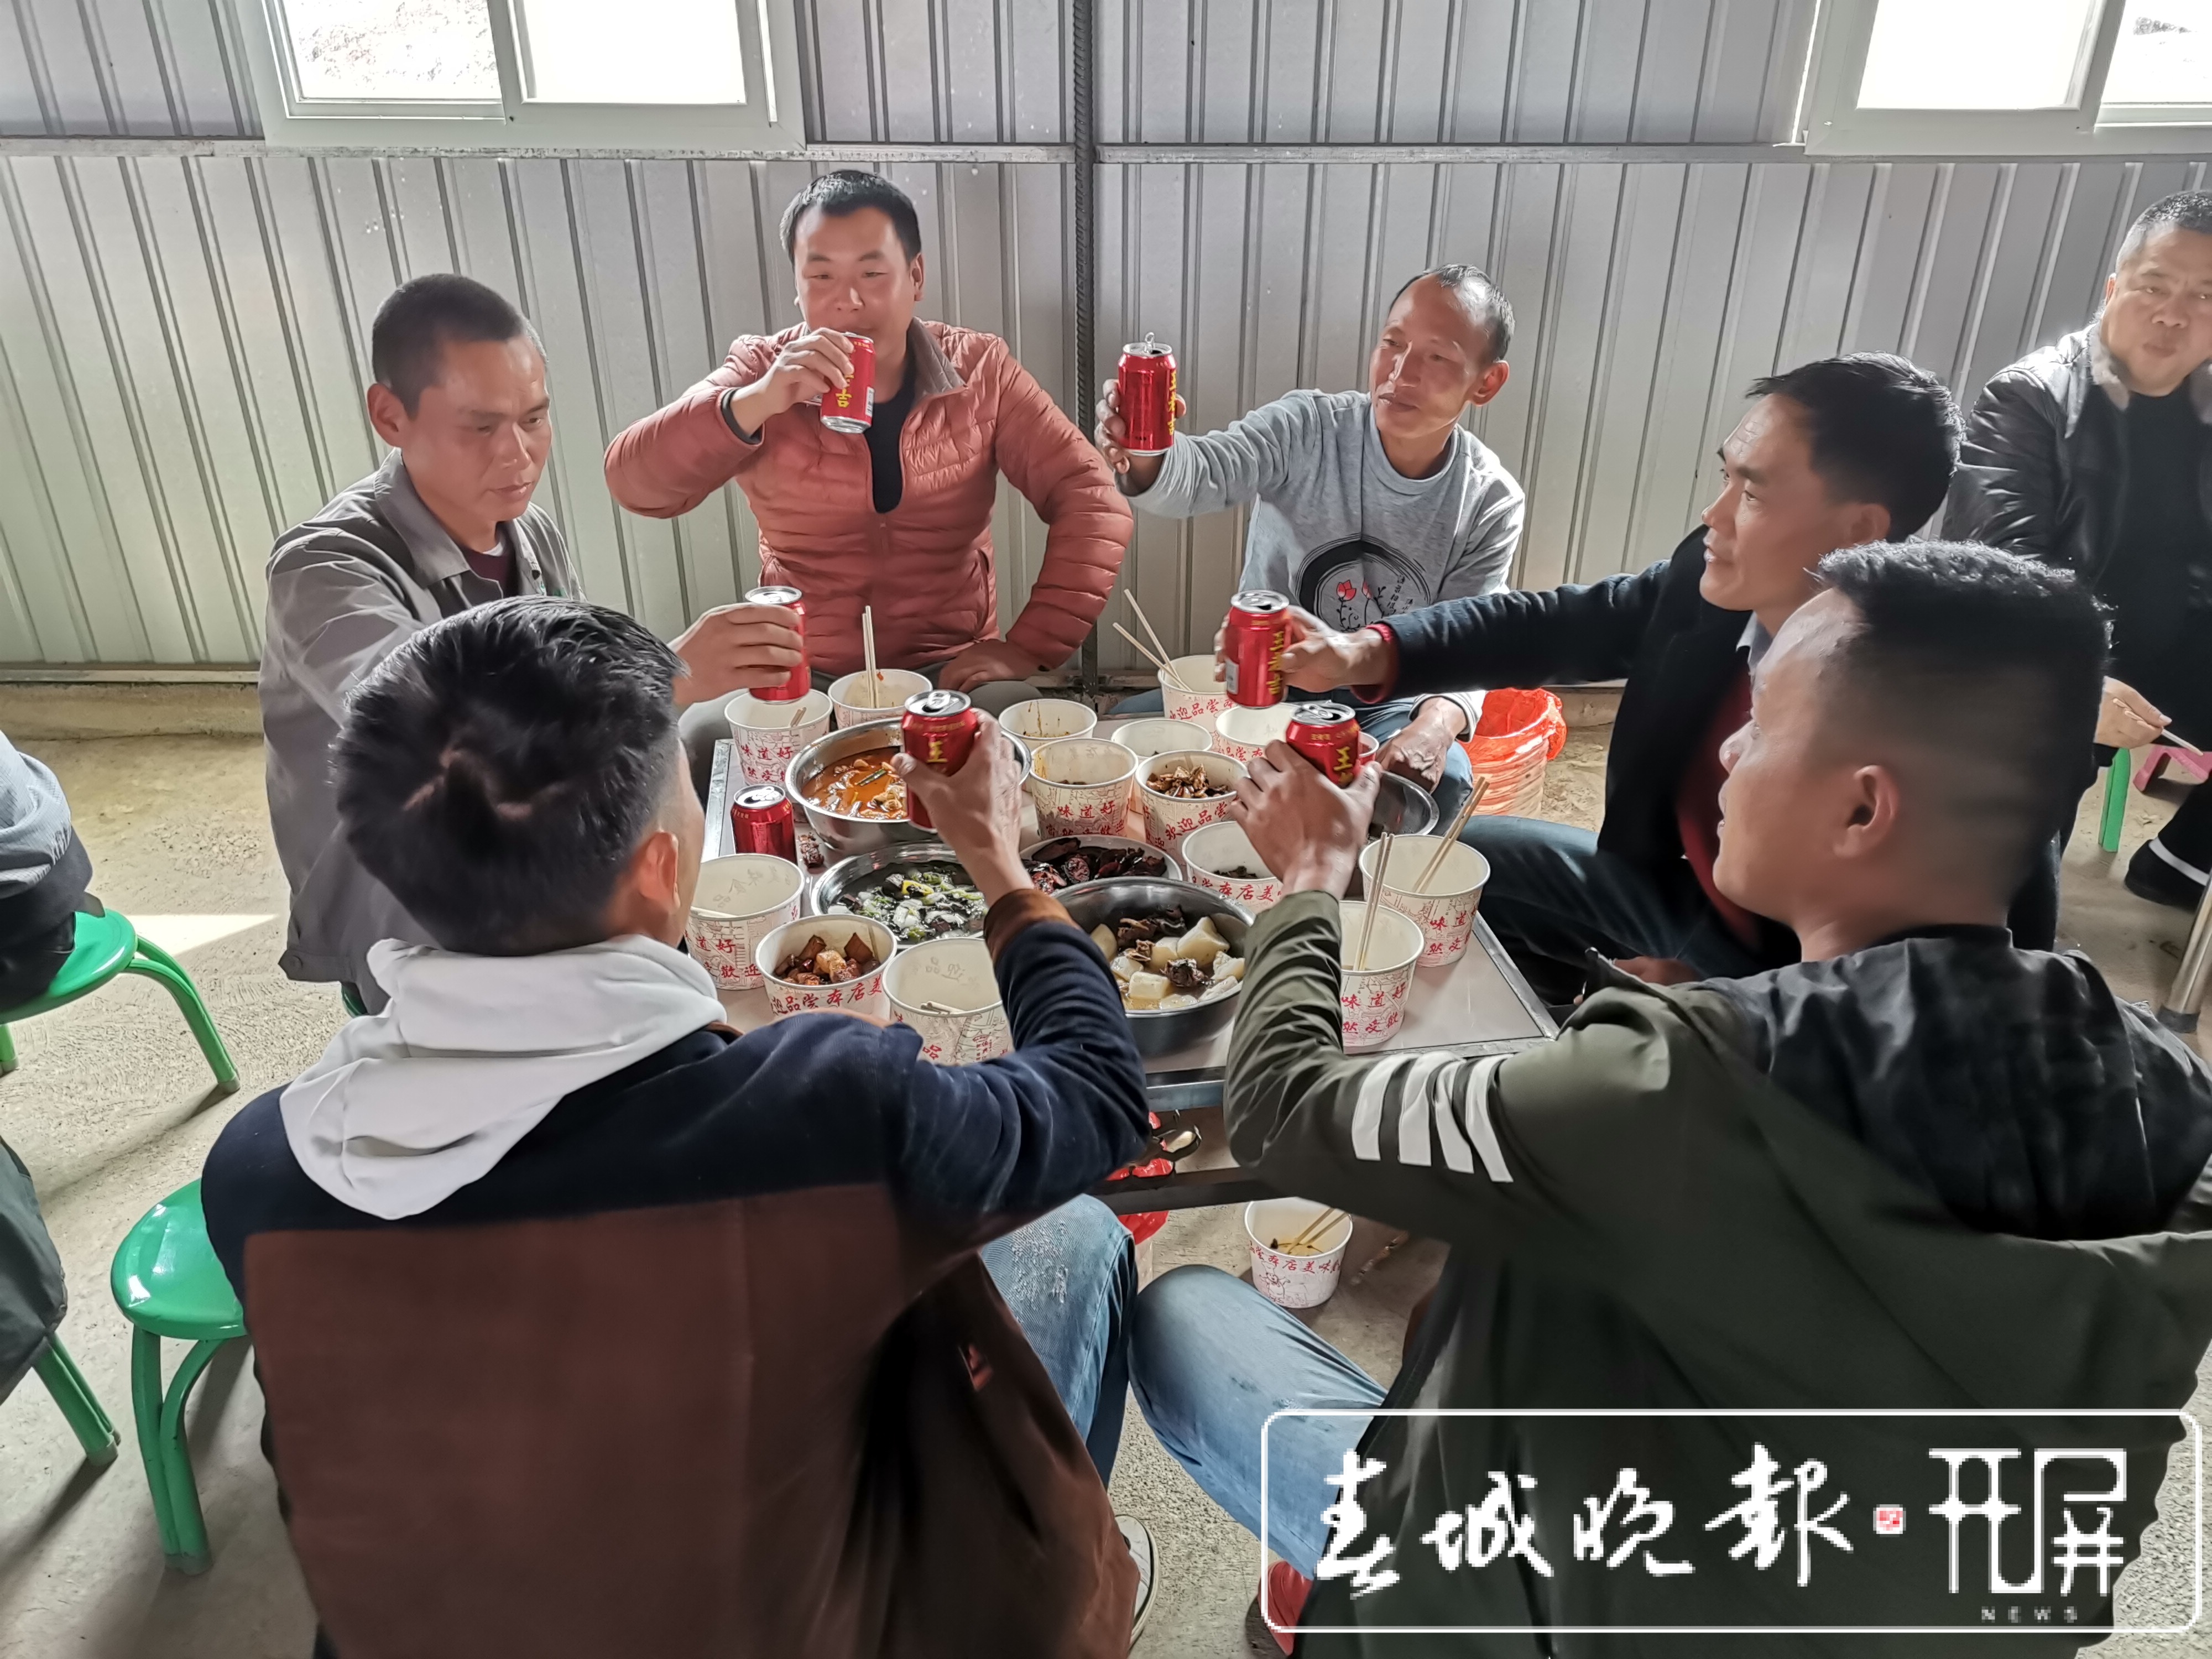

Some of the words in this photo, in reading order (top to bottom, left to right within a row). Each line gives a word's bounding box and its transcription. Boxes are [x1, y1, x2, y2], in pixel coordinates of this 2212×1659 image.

[741, 744, 794, 760] 味道好
[1057, 800, 1115, 820] 味道好
[1165, 795, 1239, 841] 欢迎品尝
[1341, 982, 1406, 1009] 味道好
